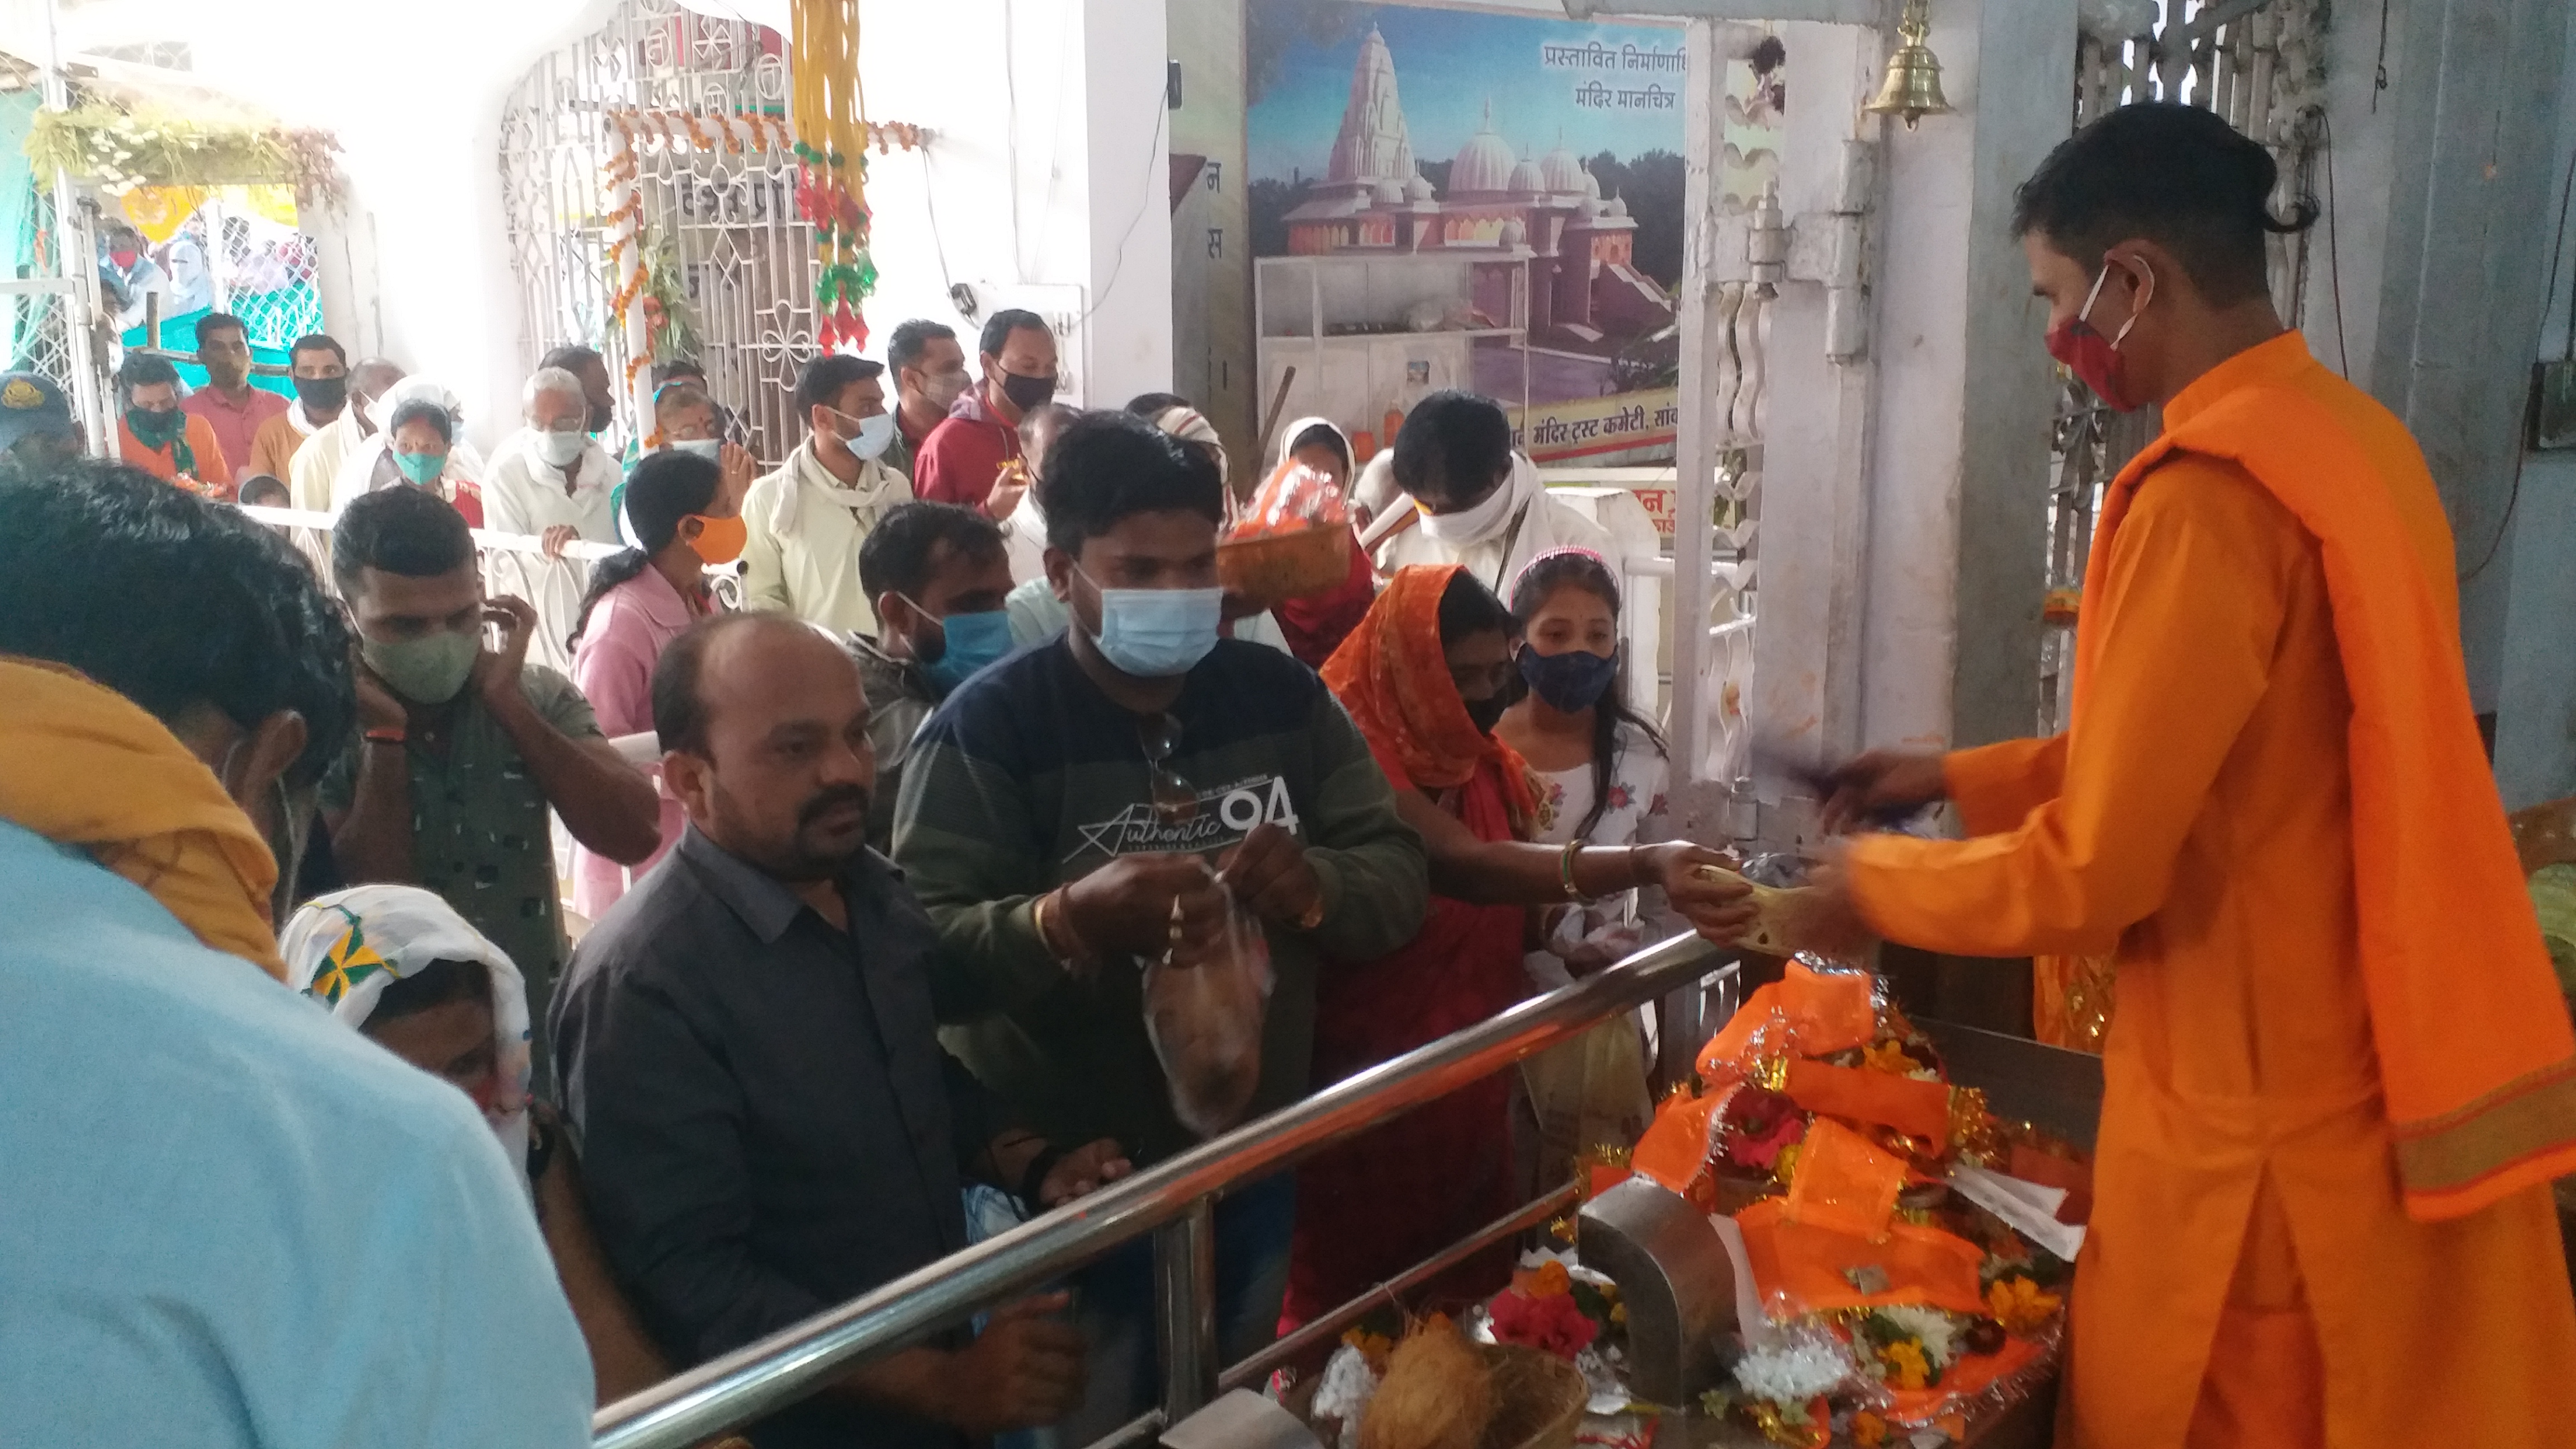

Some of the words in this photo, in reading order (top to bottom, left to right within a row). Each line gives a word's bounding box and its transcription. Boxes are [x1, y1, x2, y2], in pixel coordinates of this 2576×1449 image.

[1544, 41, 1617, 69] प्रस्तावित
[1575, 80, 1613, 108] मंदिर
[1617, 83, 1675, 110] मानचित्र
[1533, 416, 1568, 444] मंदिर
